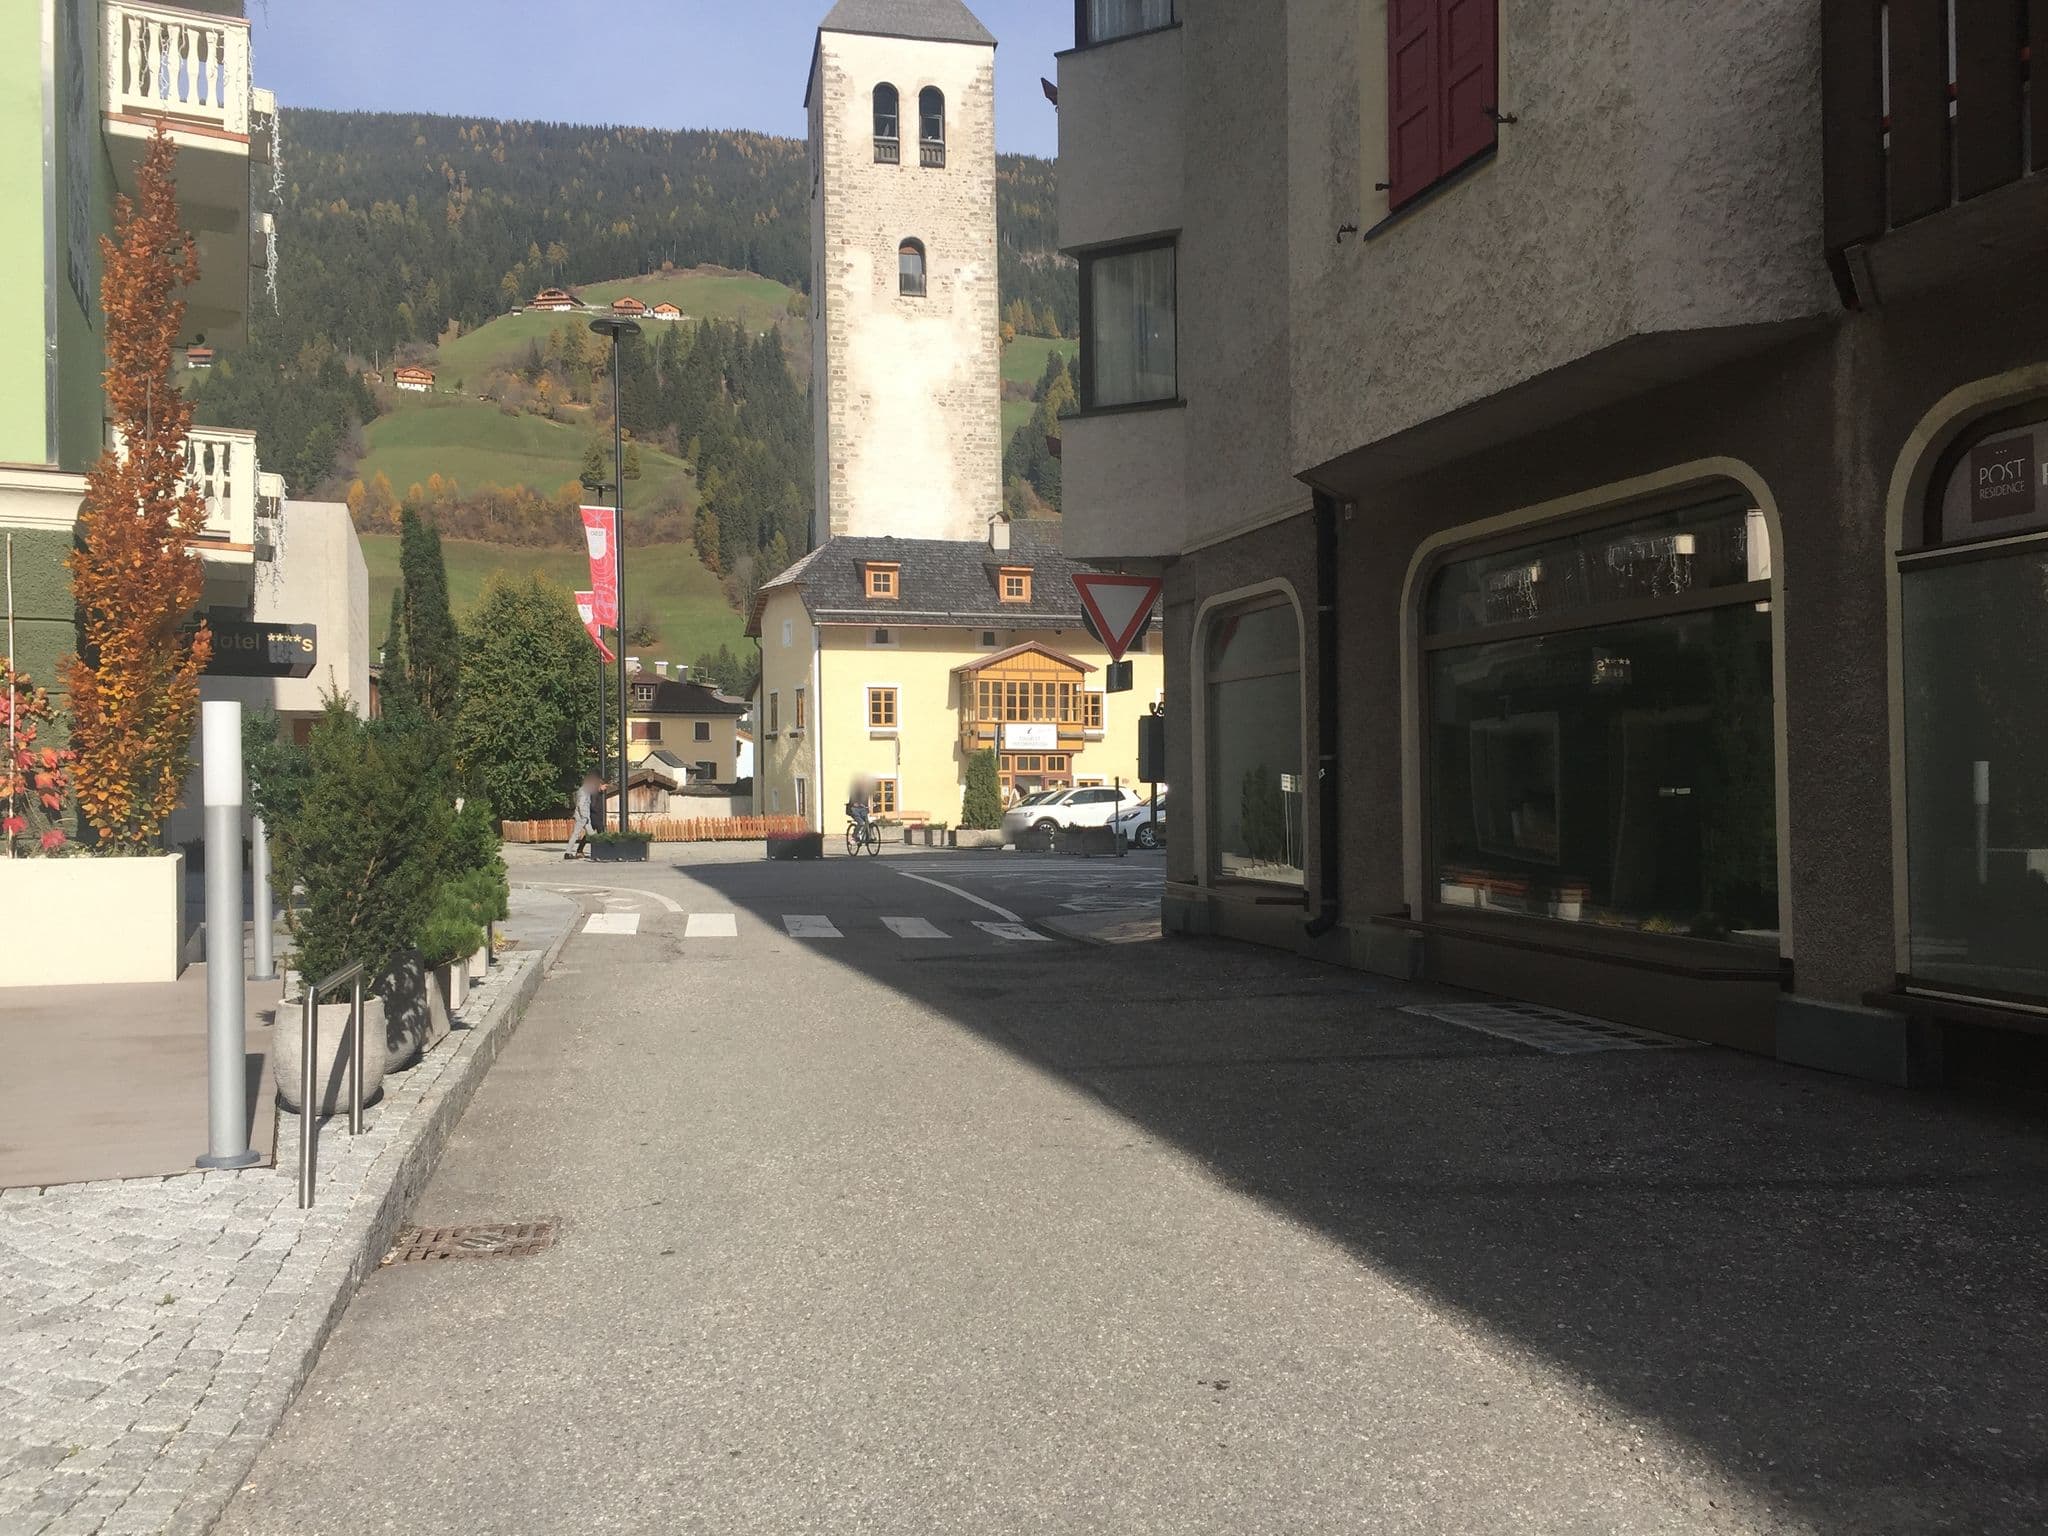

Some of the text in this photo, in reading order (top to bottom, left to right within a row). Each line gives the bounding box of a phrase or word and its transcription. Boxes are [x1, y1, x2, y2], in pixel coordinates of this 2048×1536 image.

[1979, 458, 2026, 486] POST
[1979, 480, 2025, 500] RESIDENCE
[214, 632, 260, 651] otel
